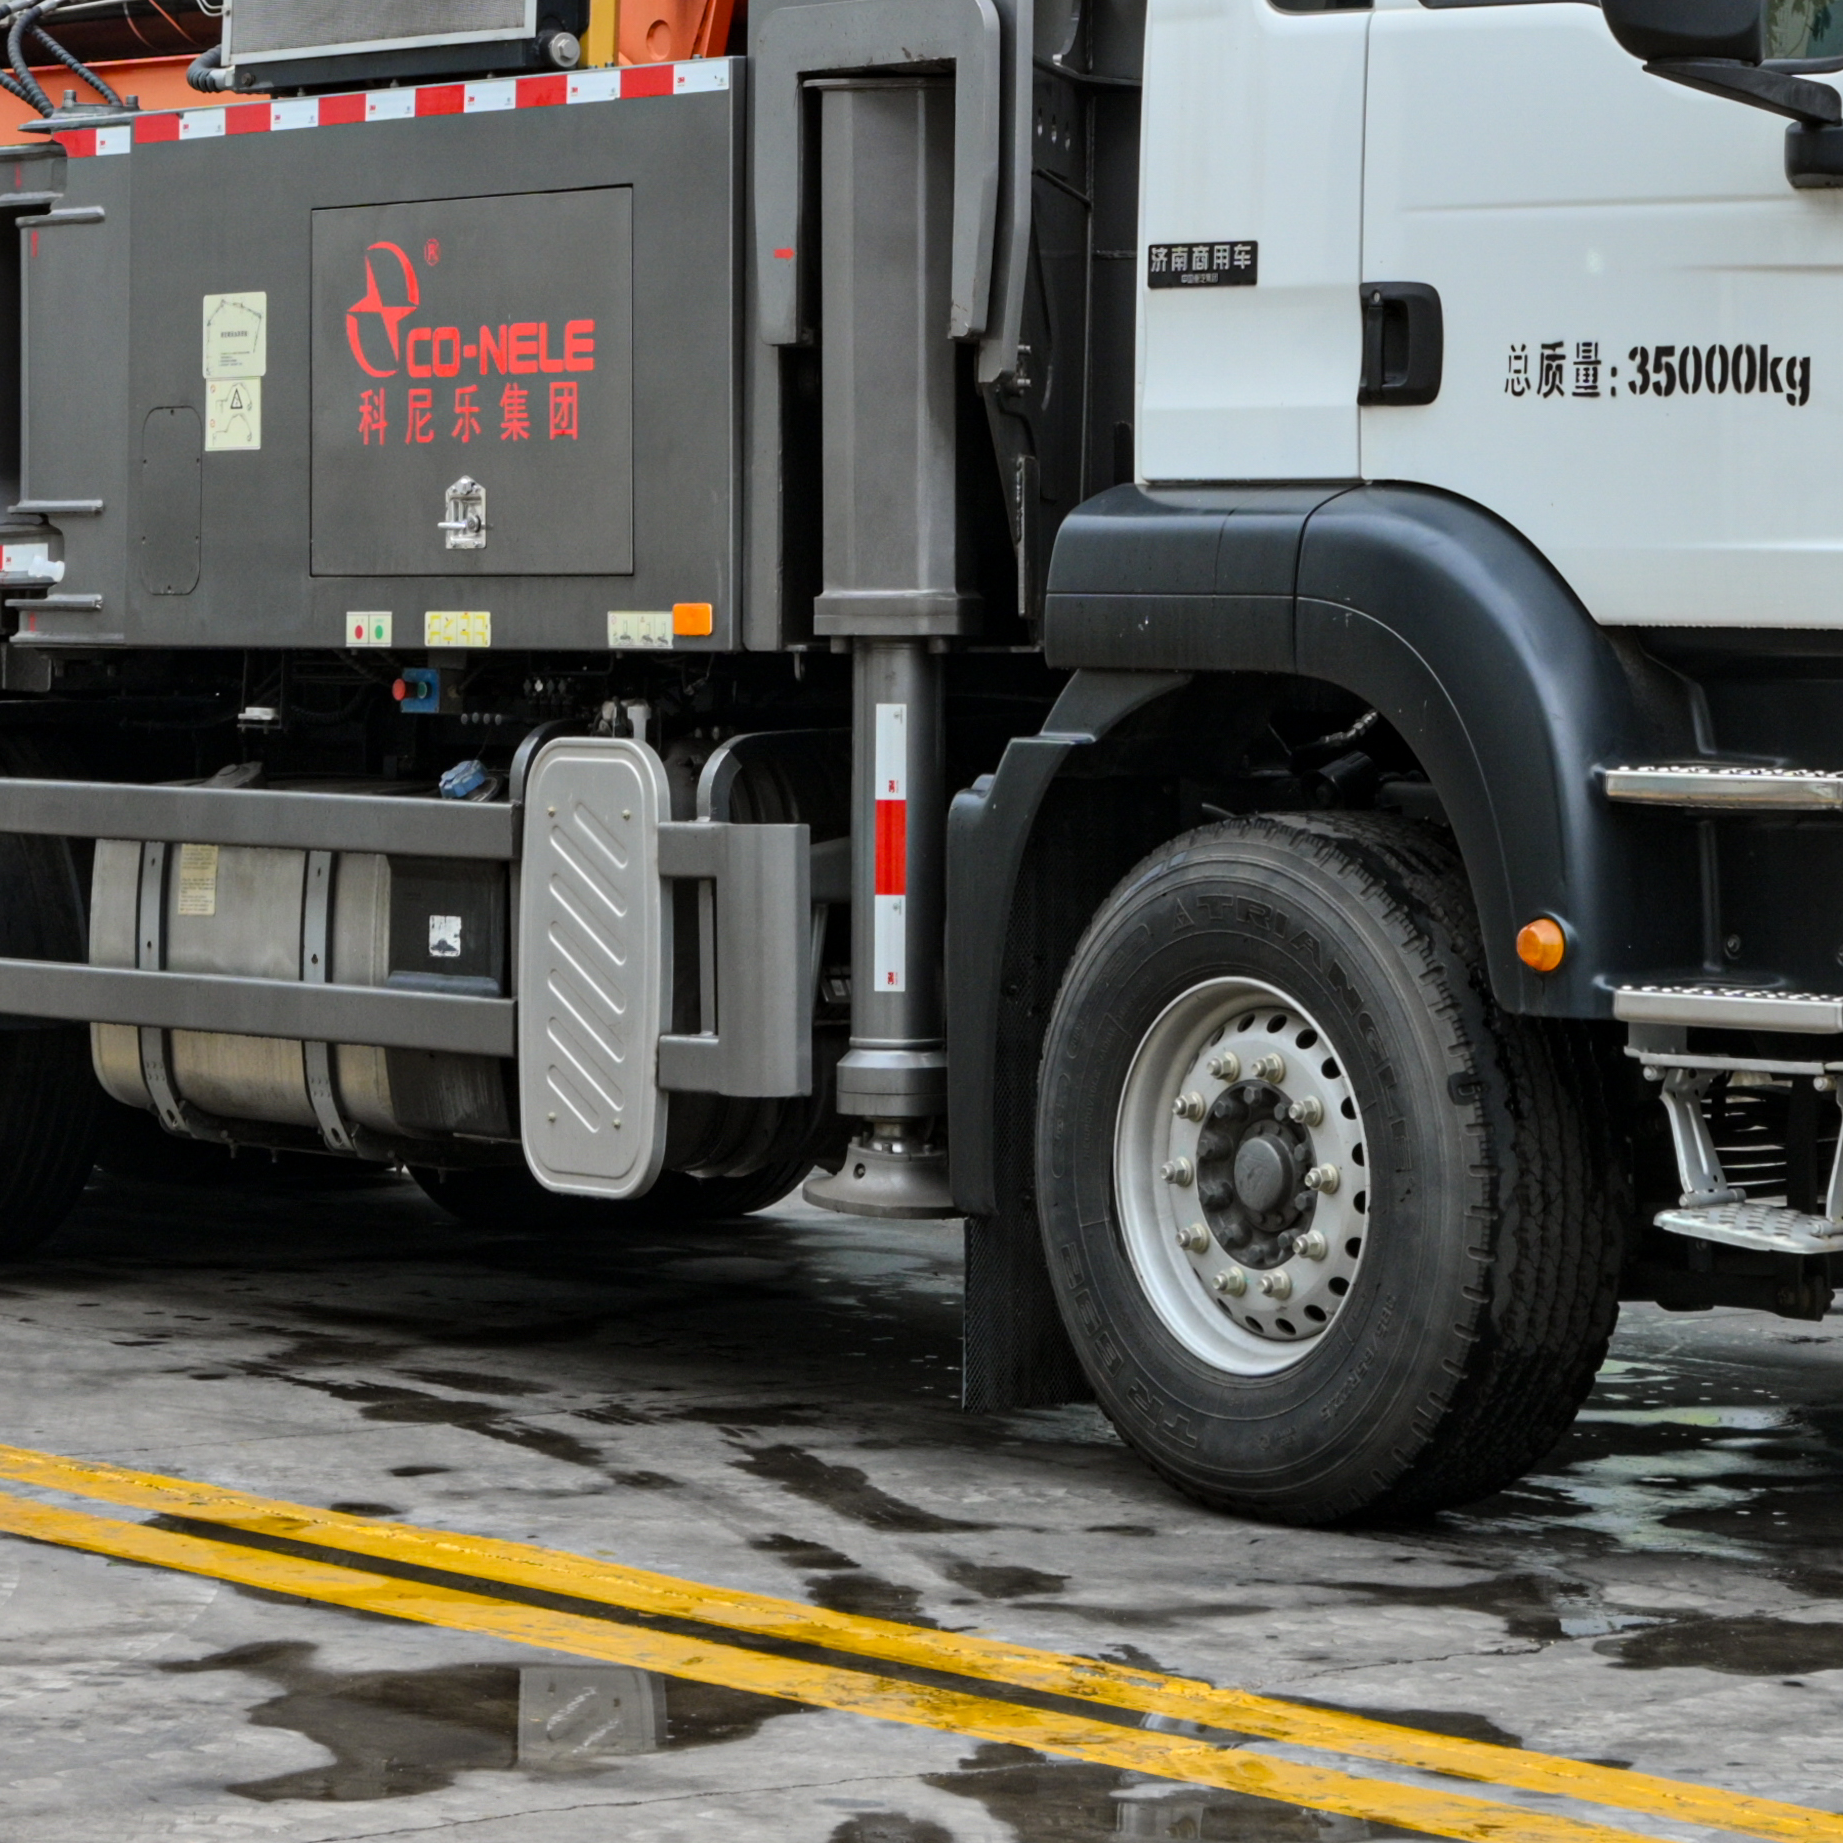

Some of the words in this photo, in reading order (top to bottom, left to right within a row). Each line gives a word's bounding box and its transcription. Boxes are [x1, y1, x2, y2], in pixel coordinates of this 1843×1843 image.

[1151, 244, 1252, 272] 济南商用车
[406, 319, 595, 378] CO-NELE
[358, 381, 579, 445] 科尼乐集团
[1196, 890, 1413, 1175] TRIANGLE
